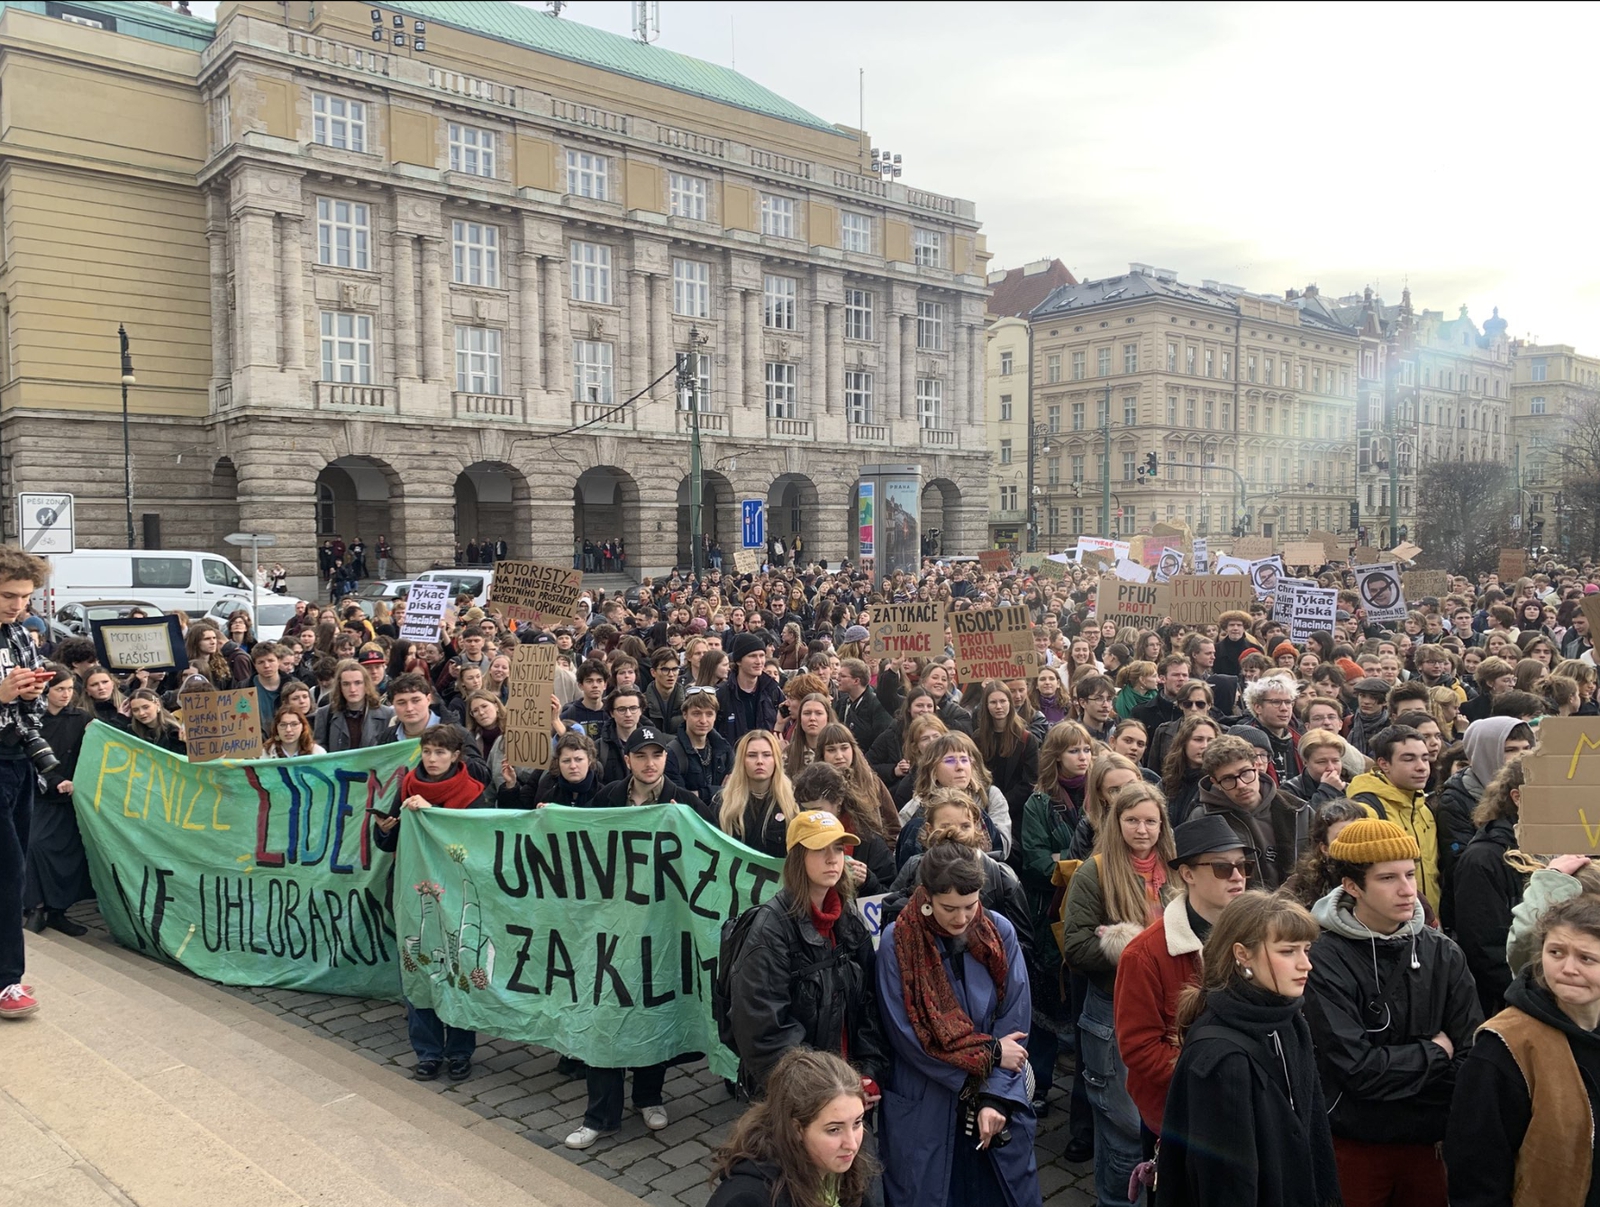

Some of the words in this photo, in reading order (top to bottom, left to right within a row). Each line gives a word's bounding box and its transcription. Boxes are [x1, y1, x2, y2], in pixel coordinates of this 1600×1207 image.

[496, 562, 572, 584] MOTORISTY
[412, 588, 445, 600] Tykač
[495, 575, 510, 585] NA
[513, 576, 580, 597] MINISTERSTVU
[1174, 579, 1189, 597] PF
[1192, 579, 1207, 597] UK
[1211, 579, 1243, 598] PROTI
[493, 584, 536, 598] ŽIVOTNÍHO
[538, 591, 577, 606] PROSTŘEDÍ
[1296, 594, 1334, 606] Tykač
[408, 600, 442, 611] píská
[534, 600, 573, 619] ORWELL
[872, 602, 939, 624] ZATYKAČE
[1118, 601, 1153, 615] PROTI
[1295, 605, 1332, 617] píská
[1367, 608, 1394, 617] Macinku
[405, 614, 439, 626] Macinka
[896, 623, 912, 633] na
[954, 609, 1004, 633] KSOCP
[1294, 619, 1332, 630] Macinka
[110, 631, 163, 643] MOTORISTI
[402, 625, 434, 637] tancuje
[882, 631, 932, 652] TYKAČE
[958, 632, 995, 647] PROTI
[118, 651, 161, 665] FAŠISTI
[517, 644, 557, 663] STÁTNÍ
[960, 643, 1013, 661] RASISMU
[511, 663, 554, 682] INSTITUCE
[960, 666, 971, 676] a
[511, 682, 541, 698] BEROU
[184, 694, 210, 710] MŽP
[216, 690, 238, 706] MÁ
[641, 728, 655, 740] LA
[189, 740, 206, 757] NE
[507, 729, 549, 766] PROUD
[242, 763, 409, 875] LIDEM
[504, 923, 579, 1004] ZA
